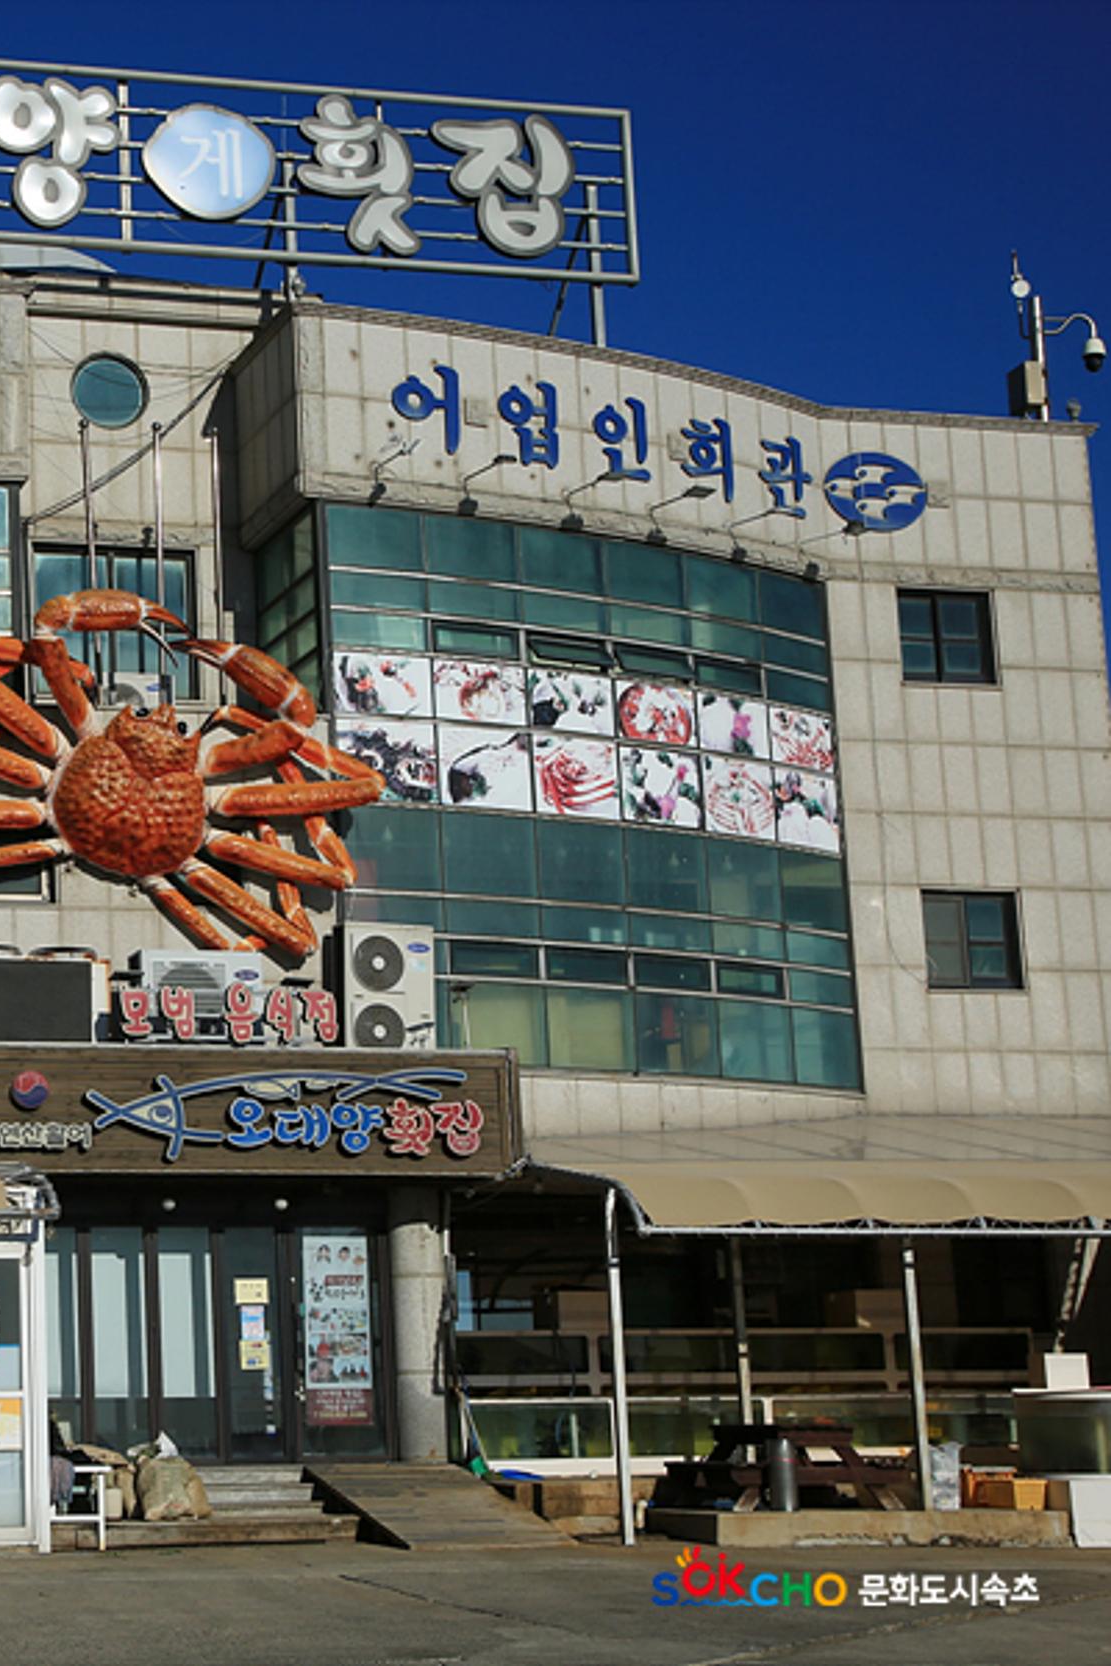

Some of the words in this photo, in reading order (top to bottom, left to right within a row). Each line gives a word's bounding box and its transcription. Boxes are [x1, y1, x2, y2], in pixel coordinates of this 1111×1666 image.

[297, 94, 576, 259] 횟집
[120, 985, 195, 1041] 모범
[224, 981, 339, 1043] 음식점
